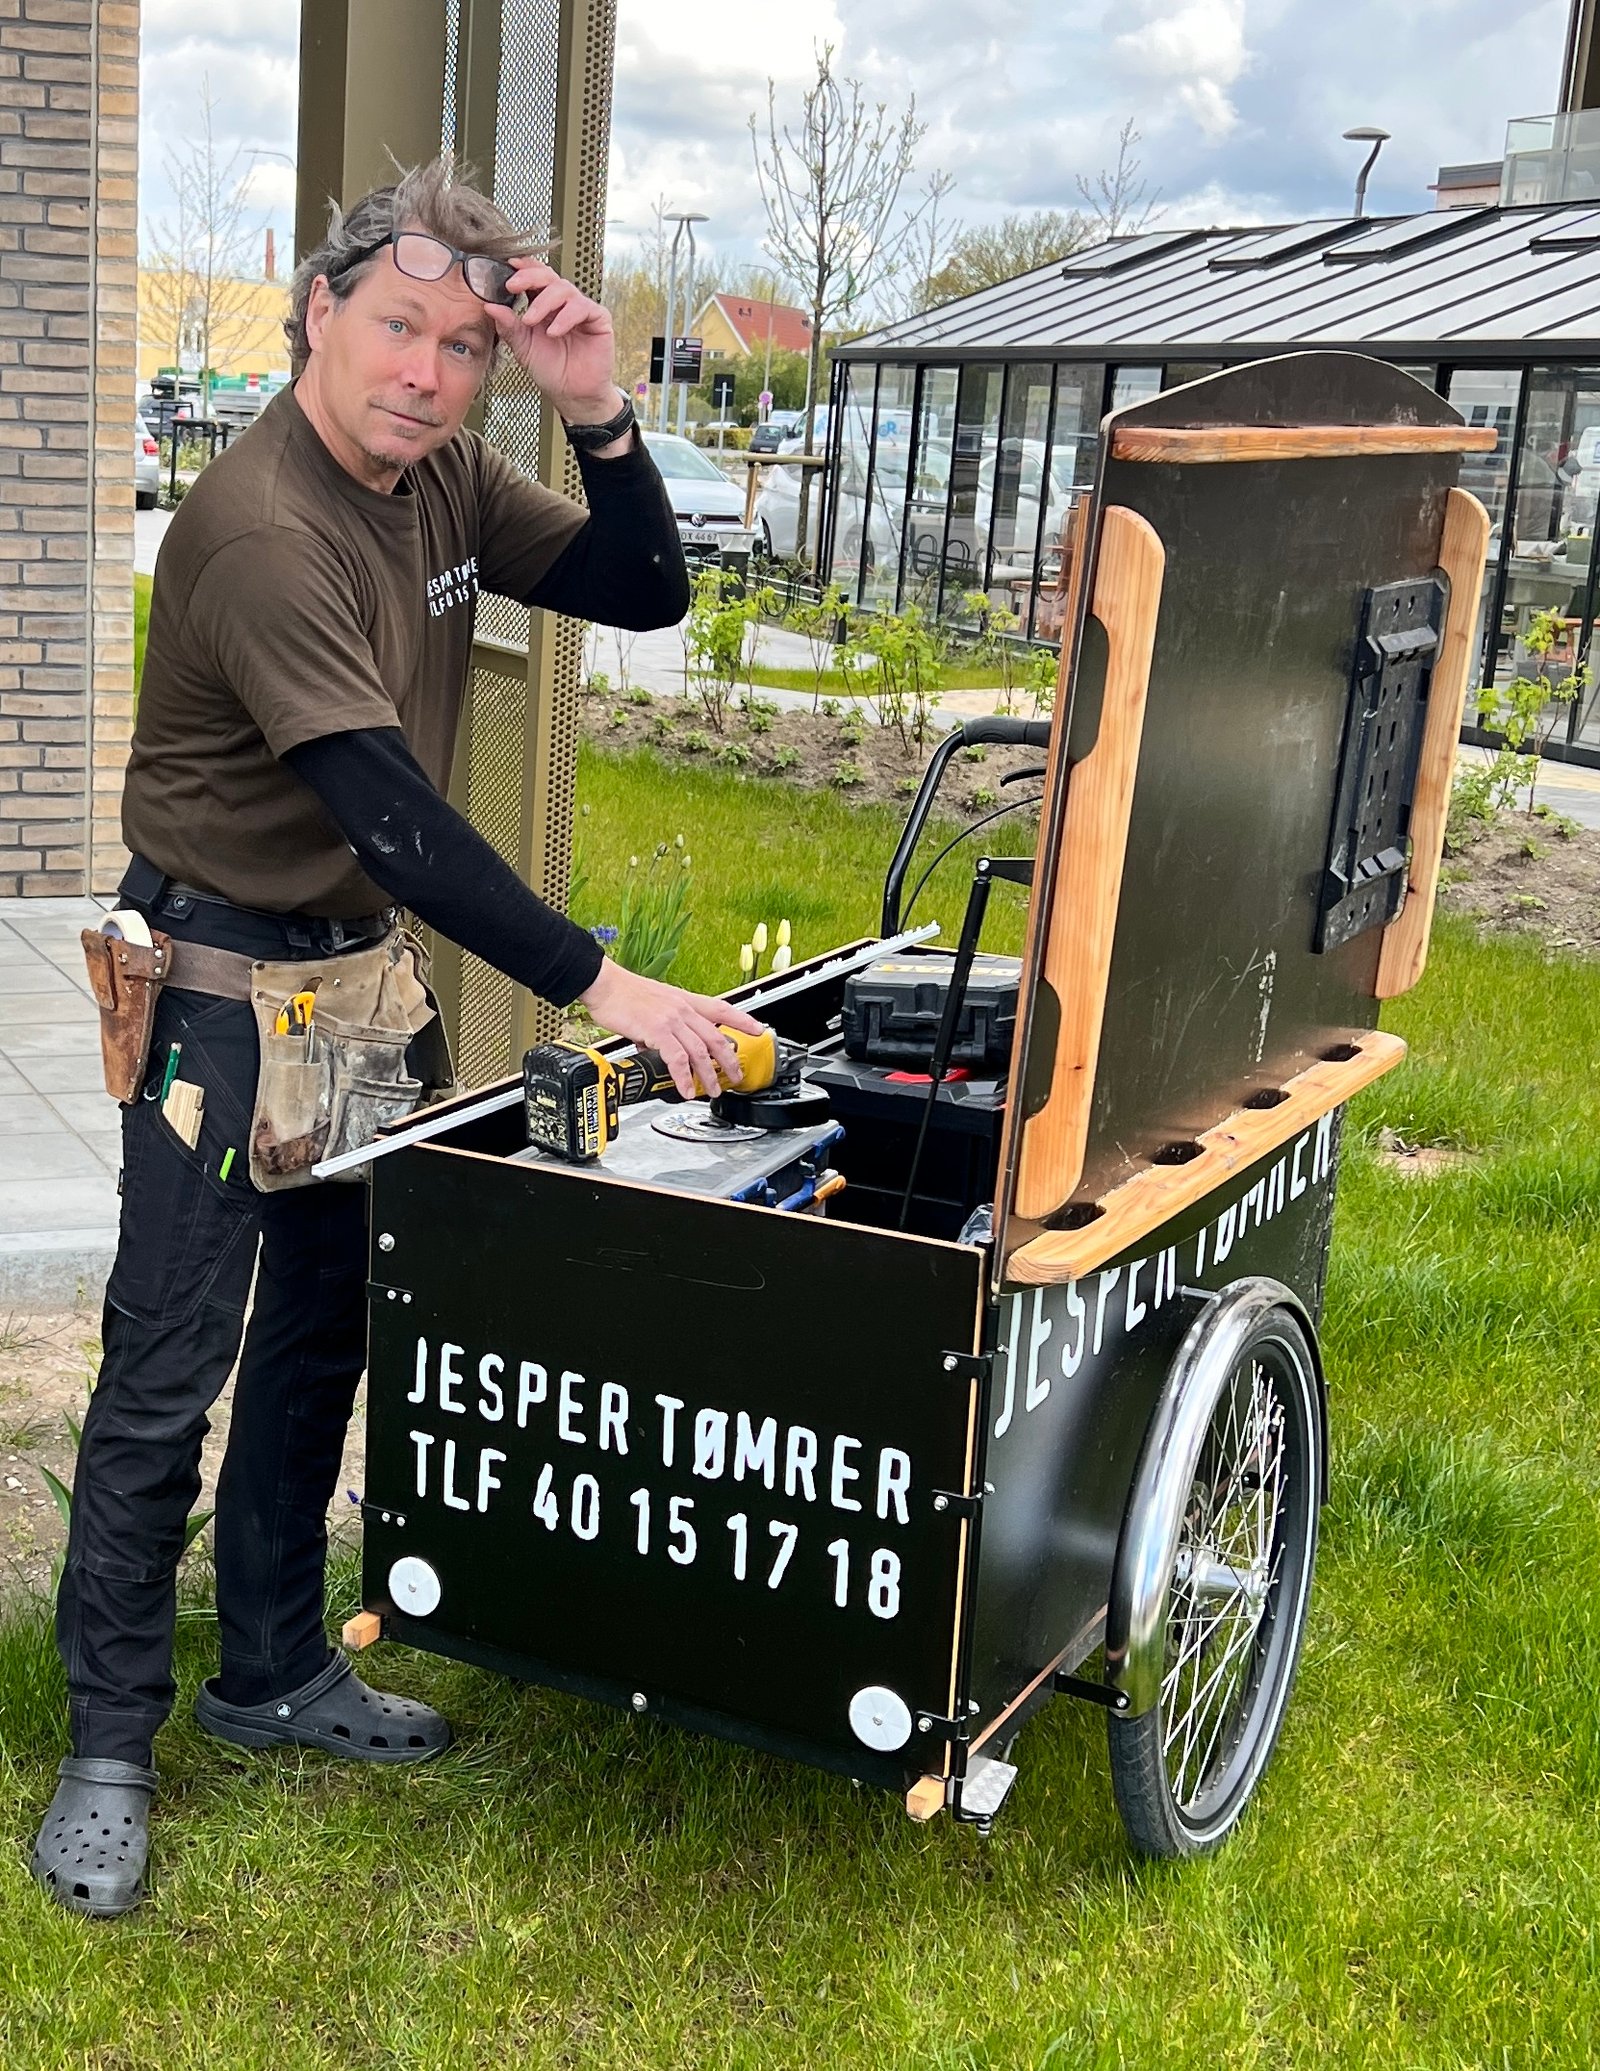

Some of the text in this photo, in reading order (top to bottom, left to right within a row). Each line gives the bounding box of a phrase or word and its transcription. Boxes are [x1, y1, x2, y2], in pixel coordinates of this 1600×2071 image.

[408, 1337, 911, 1525] JESPER TØMRER
[410, 1430, 900, 1619] TLF 40 15 17 18
